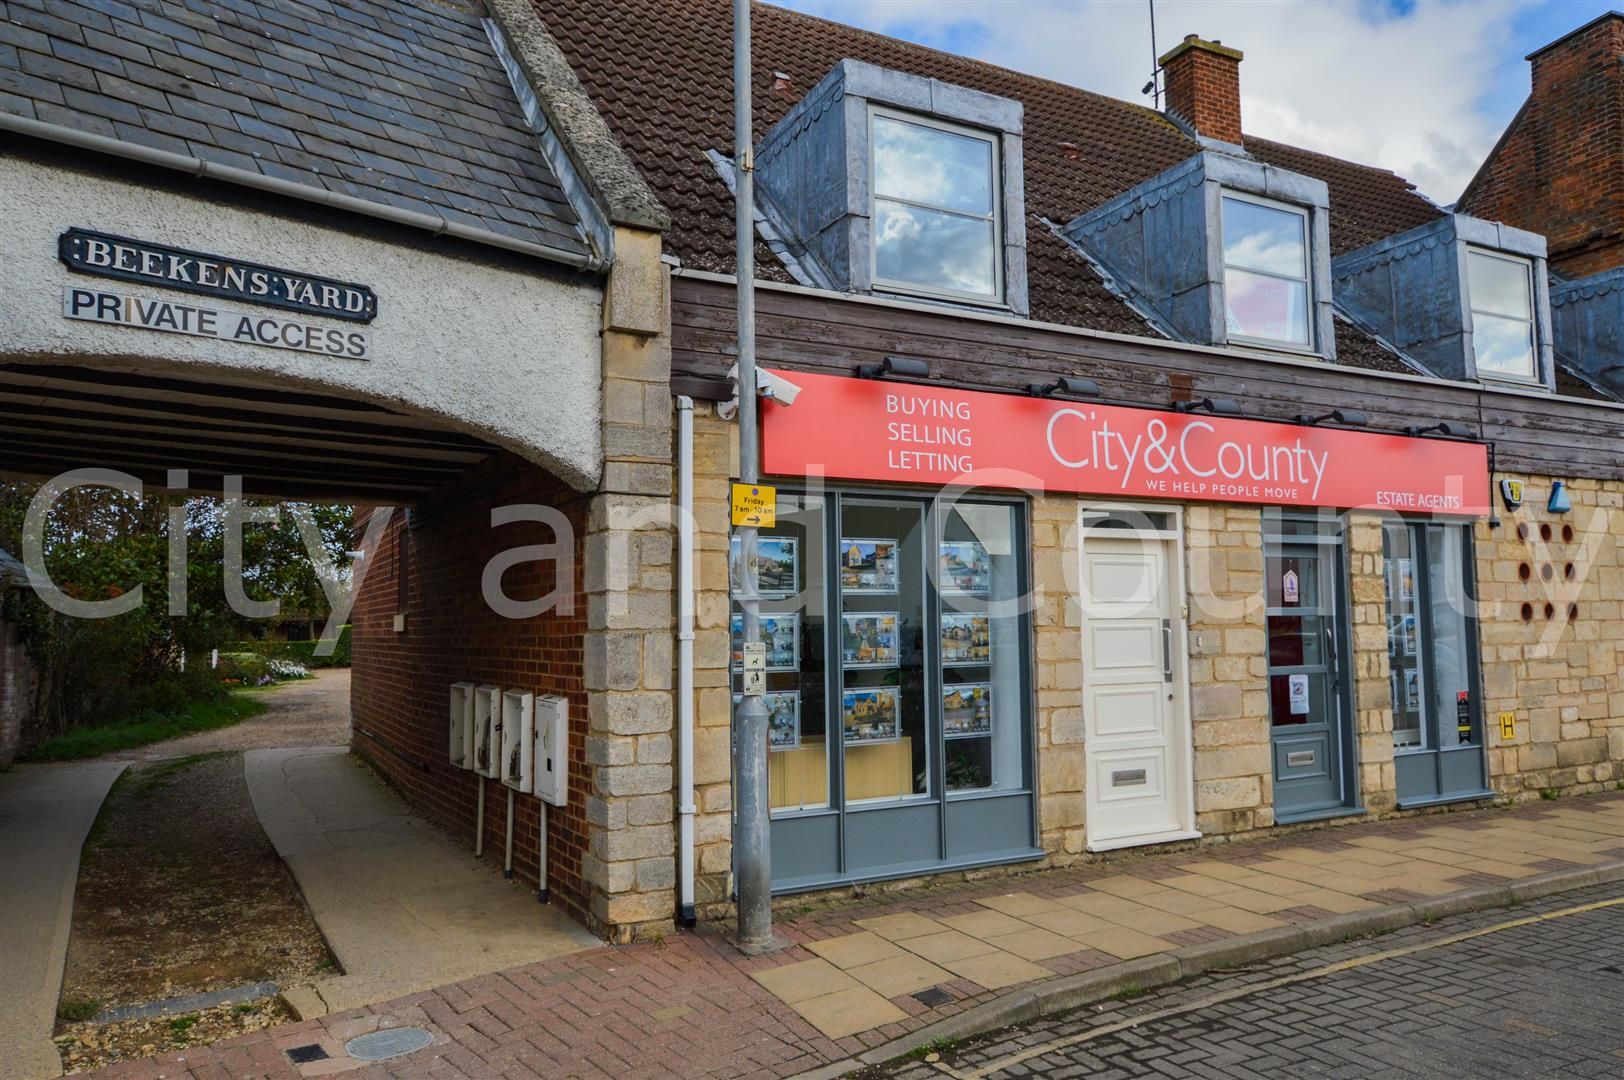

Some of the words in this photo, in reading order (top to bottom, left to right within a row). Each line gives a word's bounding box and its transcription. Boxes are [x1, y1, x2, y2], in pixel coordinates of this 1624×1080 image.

[71, 288, 218, 336] PRIVATE
[233, 316, 366, 358] ACCESS
[886, 394, 971, 420] BUYING
[887, 422, 972, 447] SELLING
[888, 449, 973, 473] LETTING
[744, 497, 764, 506] Friday
[1146, 480, 1167, 492] WE
[1173, 482, 1206, 495] HELP
[1212, 484, 1259, 497] PEOPLE
[1264, 487, 1298, 499] MOVE
[1376, 491, 1415, 506] ESTATE
[1417, 495, 1460, 510] AGENTS
